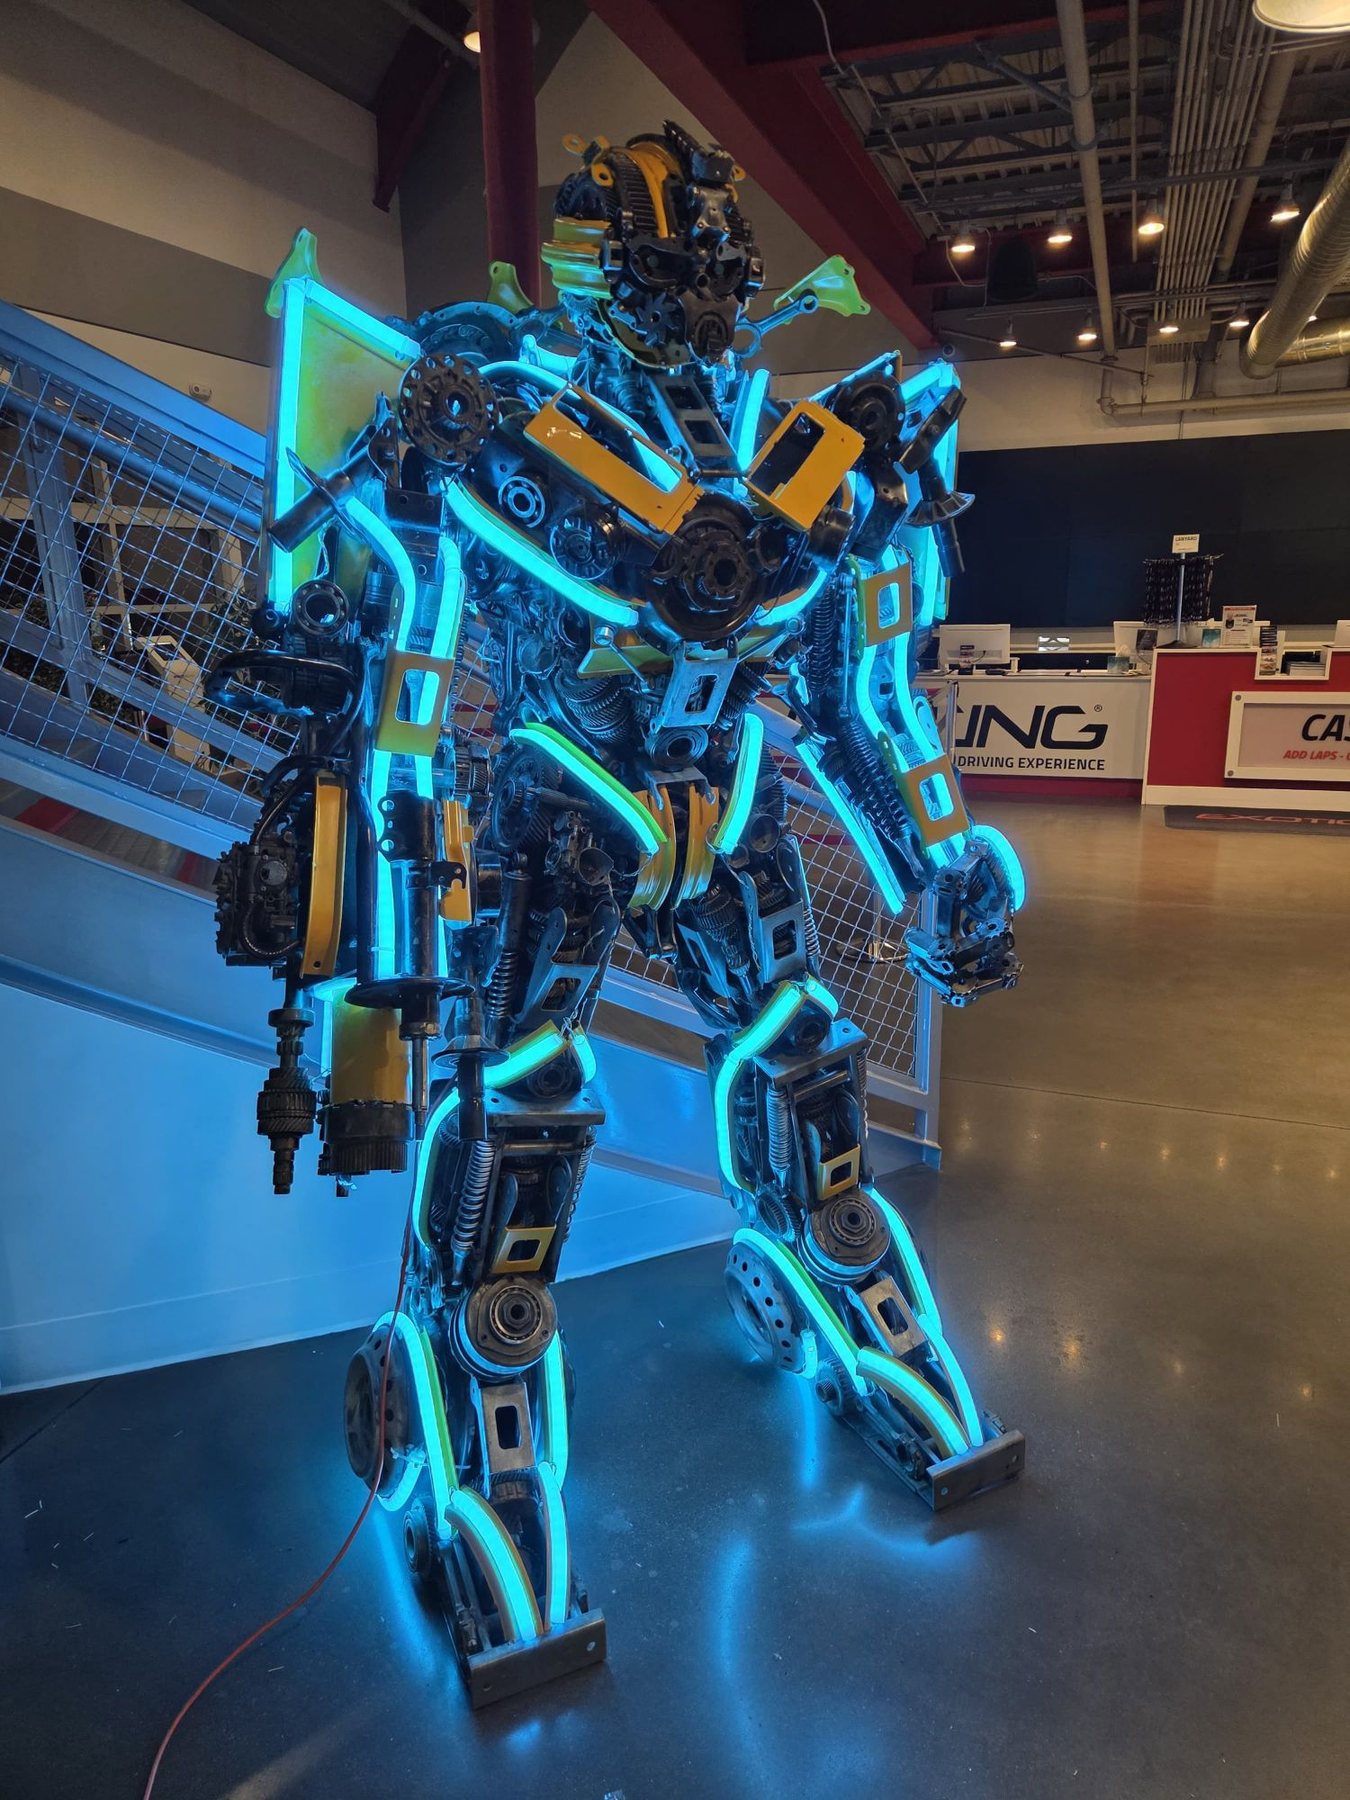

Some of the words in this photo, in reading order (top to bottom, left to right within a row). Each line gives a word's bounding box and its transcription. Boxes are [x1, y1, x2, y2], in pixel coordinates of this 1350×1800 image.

[956, 705, 1108, 749] ING
[1301, 714, 1350, 742] CA
[958, 755, 1014, 768] DRIVING
[1018, 757, 1105, 770] EXPERIENCE
[1283, 750, 1308, 760] ADD
[1309, 751, 1338, 761] LAPS
